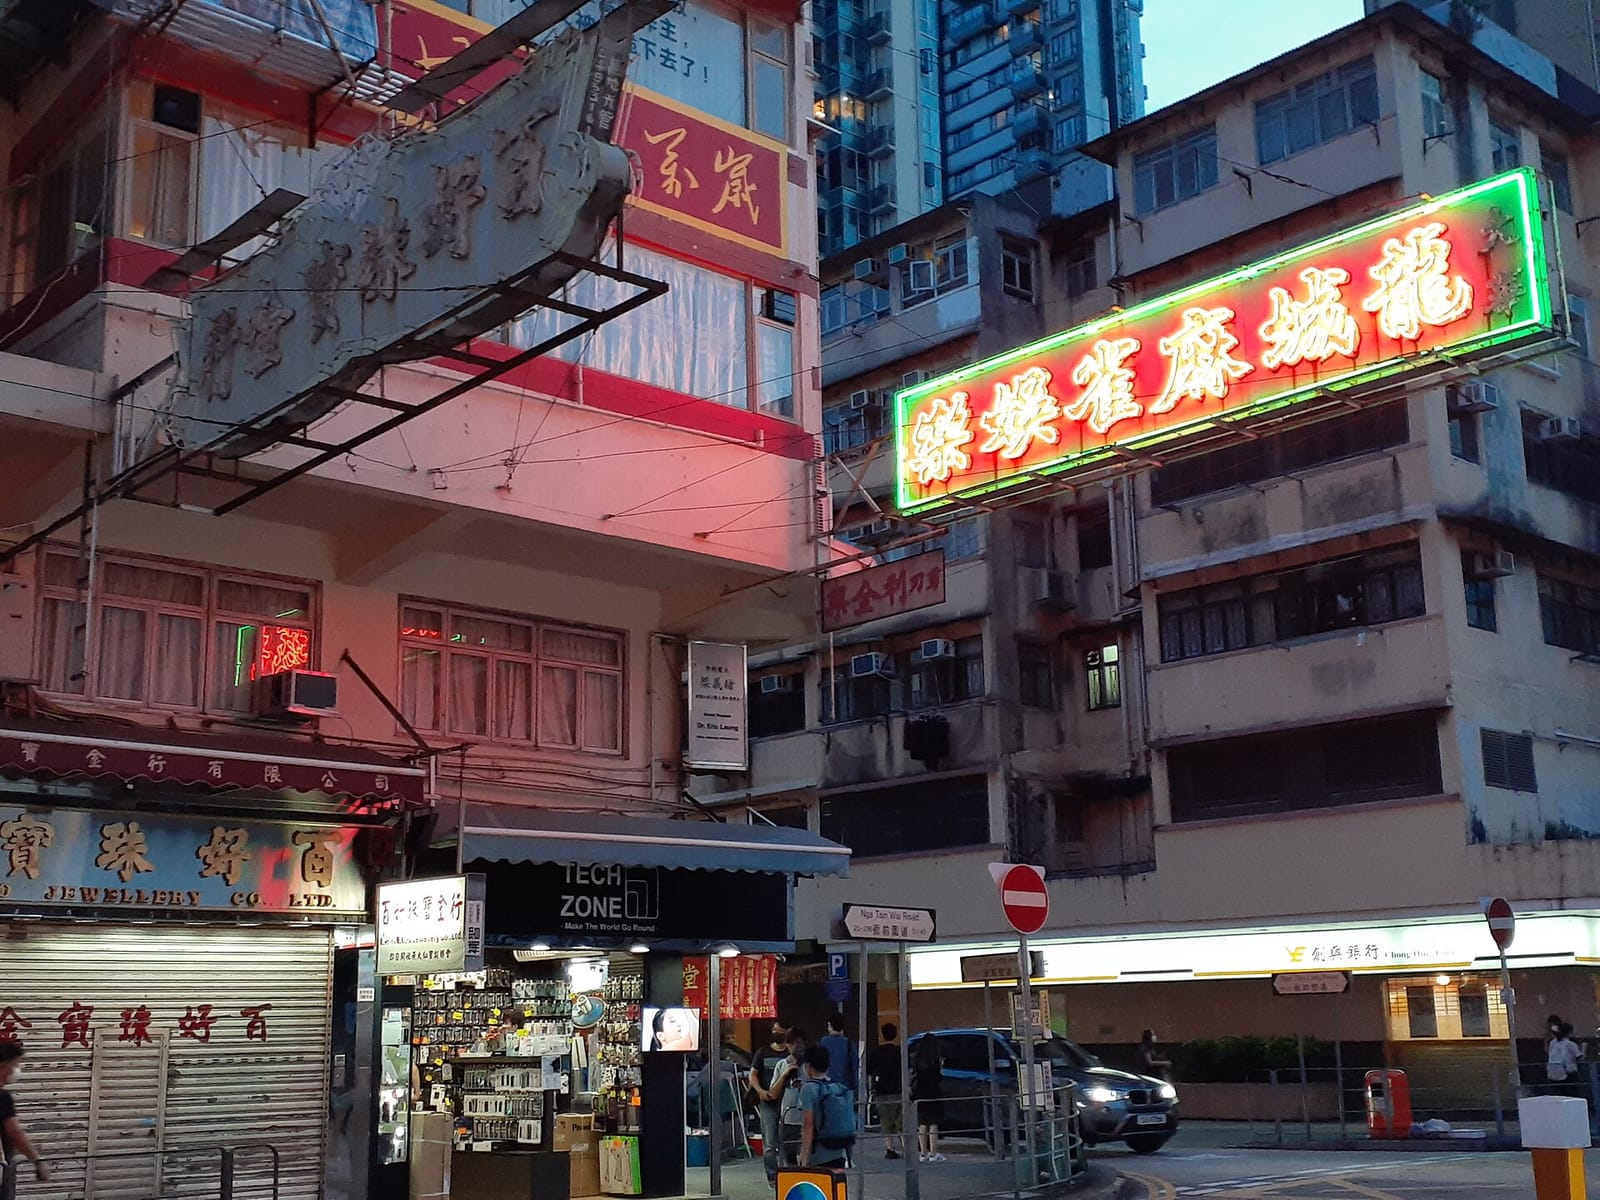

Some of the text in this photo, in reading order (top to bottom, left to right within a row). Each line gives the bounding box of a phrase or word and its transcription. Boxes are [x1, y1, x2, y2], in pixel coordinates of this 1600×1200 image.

[561, 862, 621, 886] TECH
[44, 886, 201, 906] JEWELLERY
[560, 894, 622, 918] ZONE
[564, 922, 584, 930] Make
[585, 922, 598, 930] The
[600, 923, 620, 931] World
[633, 924, 656, 932] Round
[903, 912, 920, 921] Road
[831, 954, 844, 977] P
